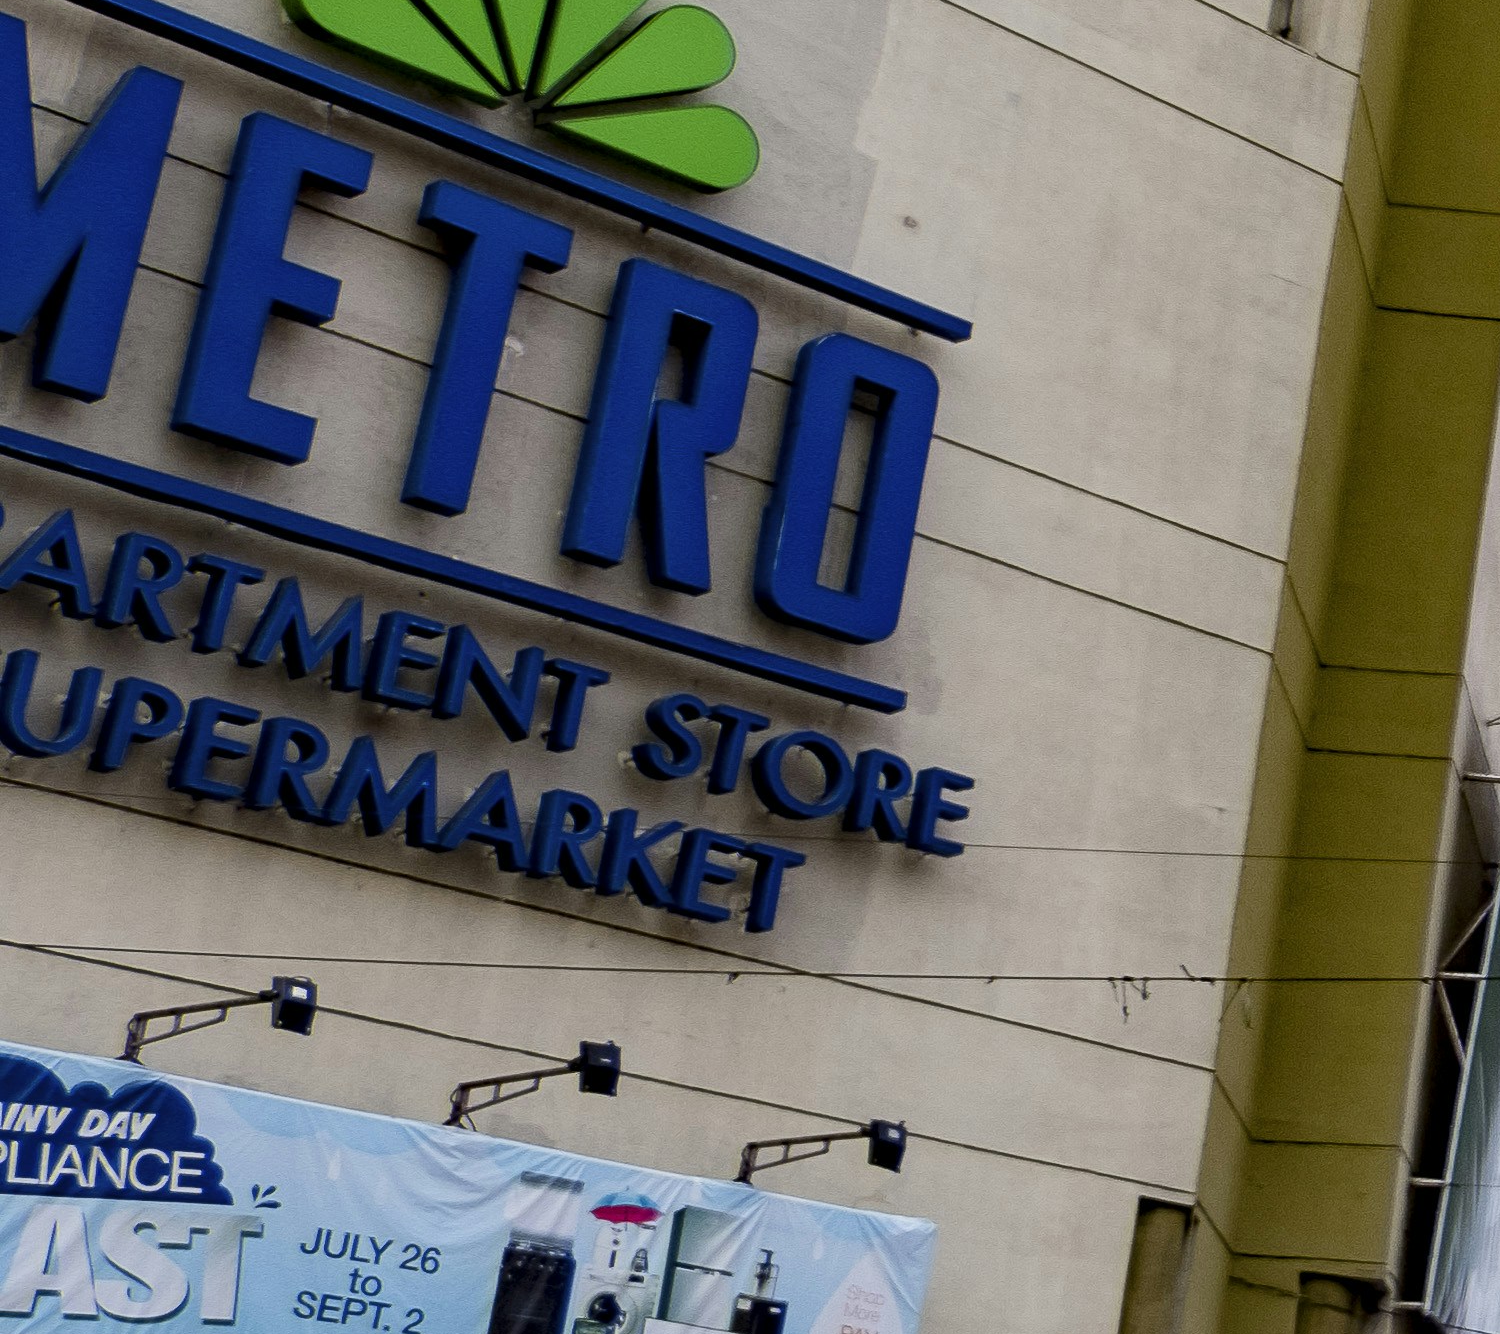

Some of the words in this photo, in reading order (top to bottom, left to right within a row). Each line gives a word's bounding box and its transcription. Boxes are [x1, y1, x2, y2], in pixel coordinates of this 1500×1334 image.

[0, 10, 939, 644] METRO
[632, 694, 975, 857] STORE
[78, 1108, 157, 1141] DAY
[300, 1226, 394, 1266] JULY
[398, 1243, 442, 1275] 26
[348, 1267, 383, 1298] to
[293, 1290, 393, 1333] SEPT.
